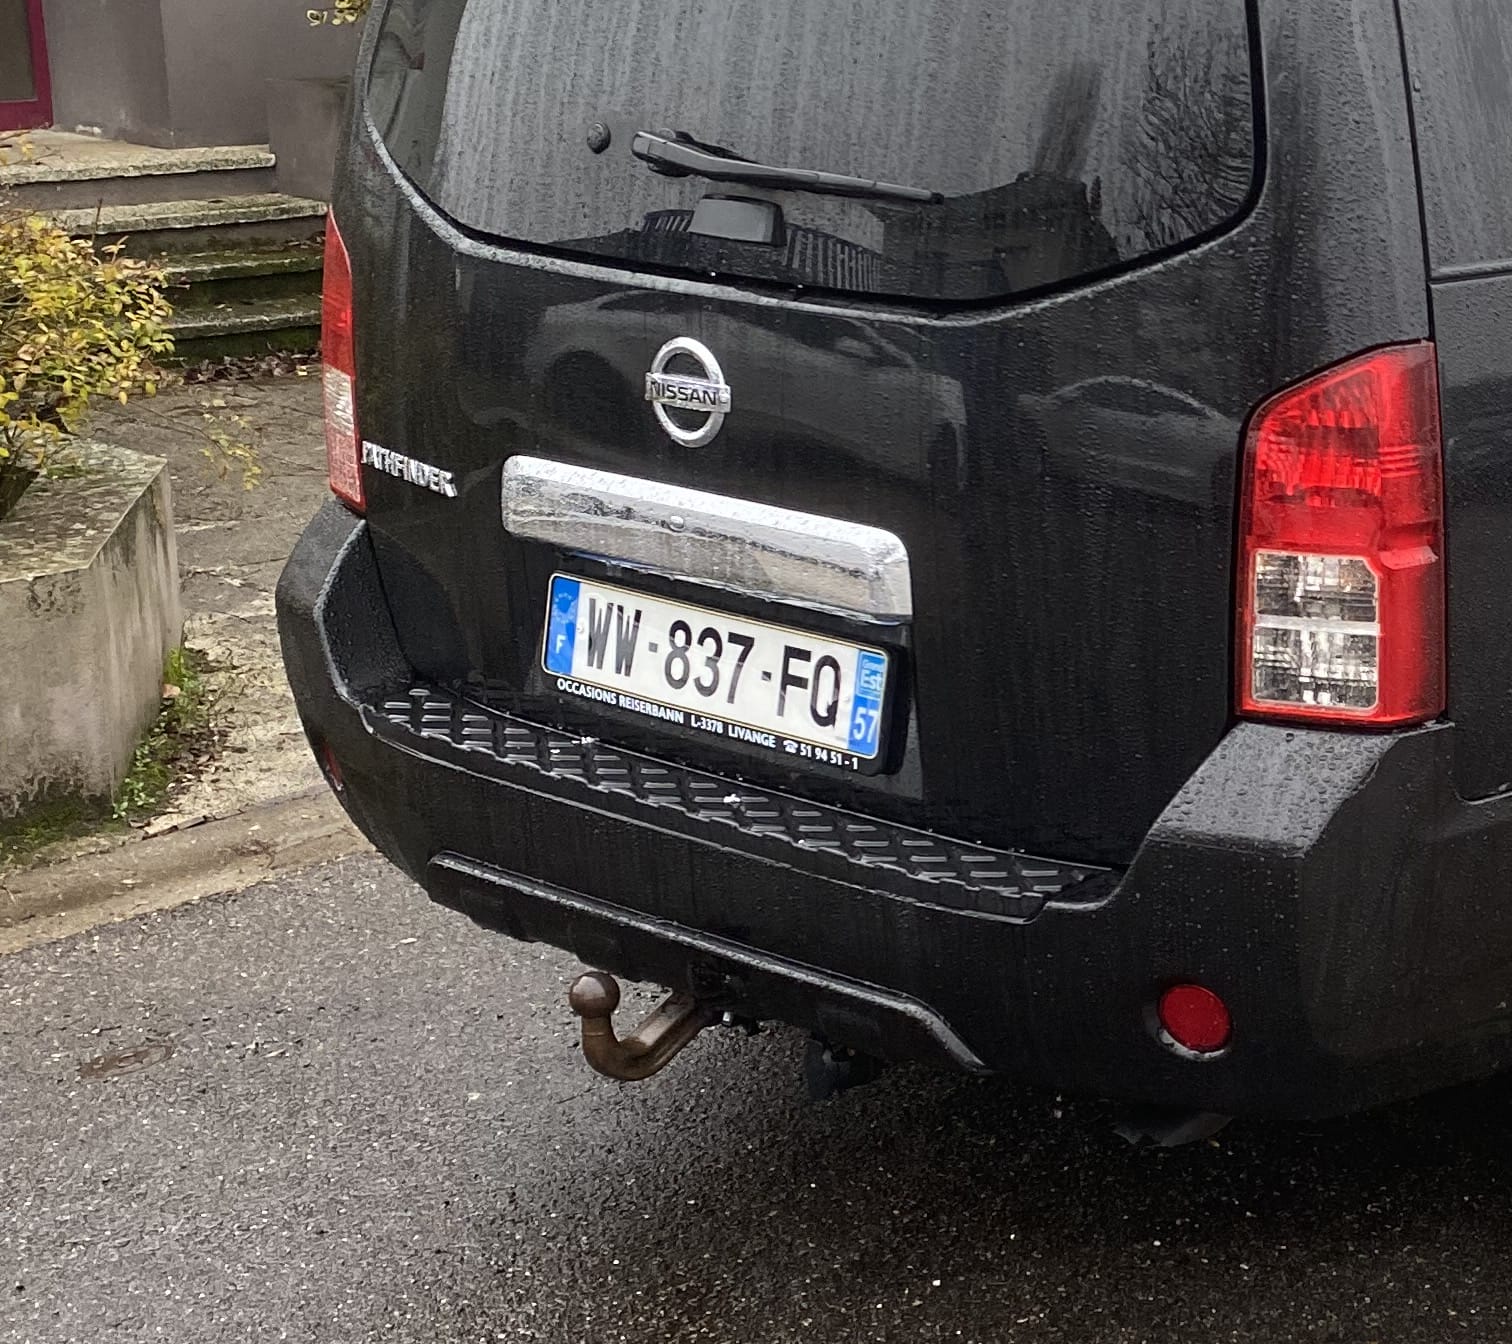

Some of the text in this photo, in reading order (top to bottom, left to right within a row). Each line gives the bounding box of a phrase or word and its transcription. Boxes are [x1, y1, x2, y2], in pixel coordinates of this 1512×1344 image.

[650, 380, 718, 406] NISSAN
[361, 440, 458, 498] PATHFINDER
[555, 634, 567, 655] F
[556, 678, 617, 706] OCCASIONS
[618, 694, 684, 724] REISERBANN
[690, 714, 724, 734] L-3378
[728, 726, 777, 749] LIVANGE
[799, 744, 812, 758] 51
[814, 747, 828, 762] 94
[853, 706, 879, 744] 57
